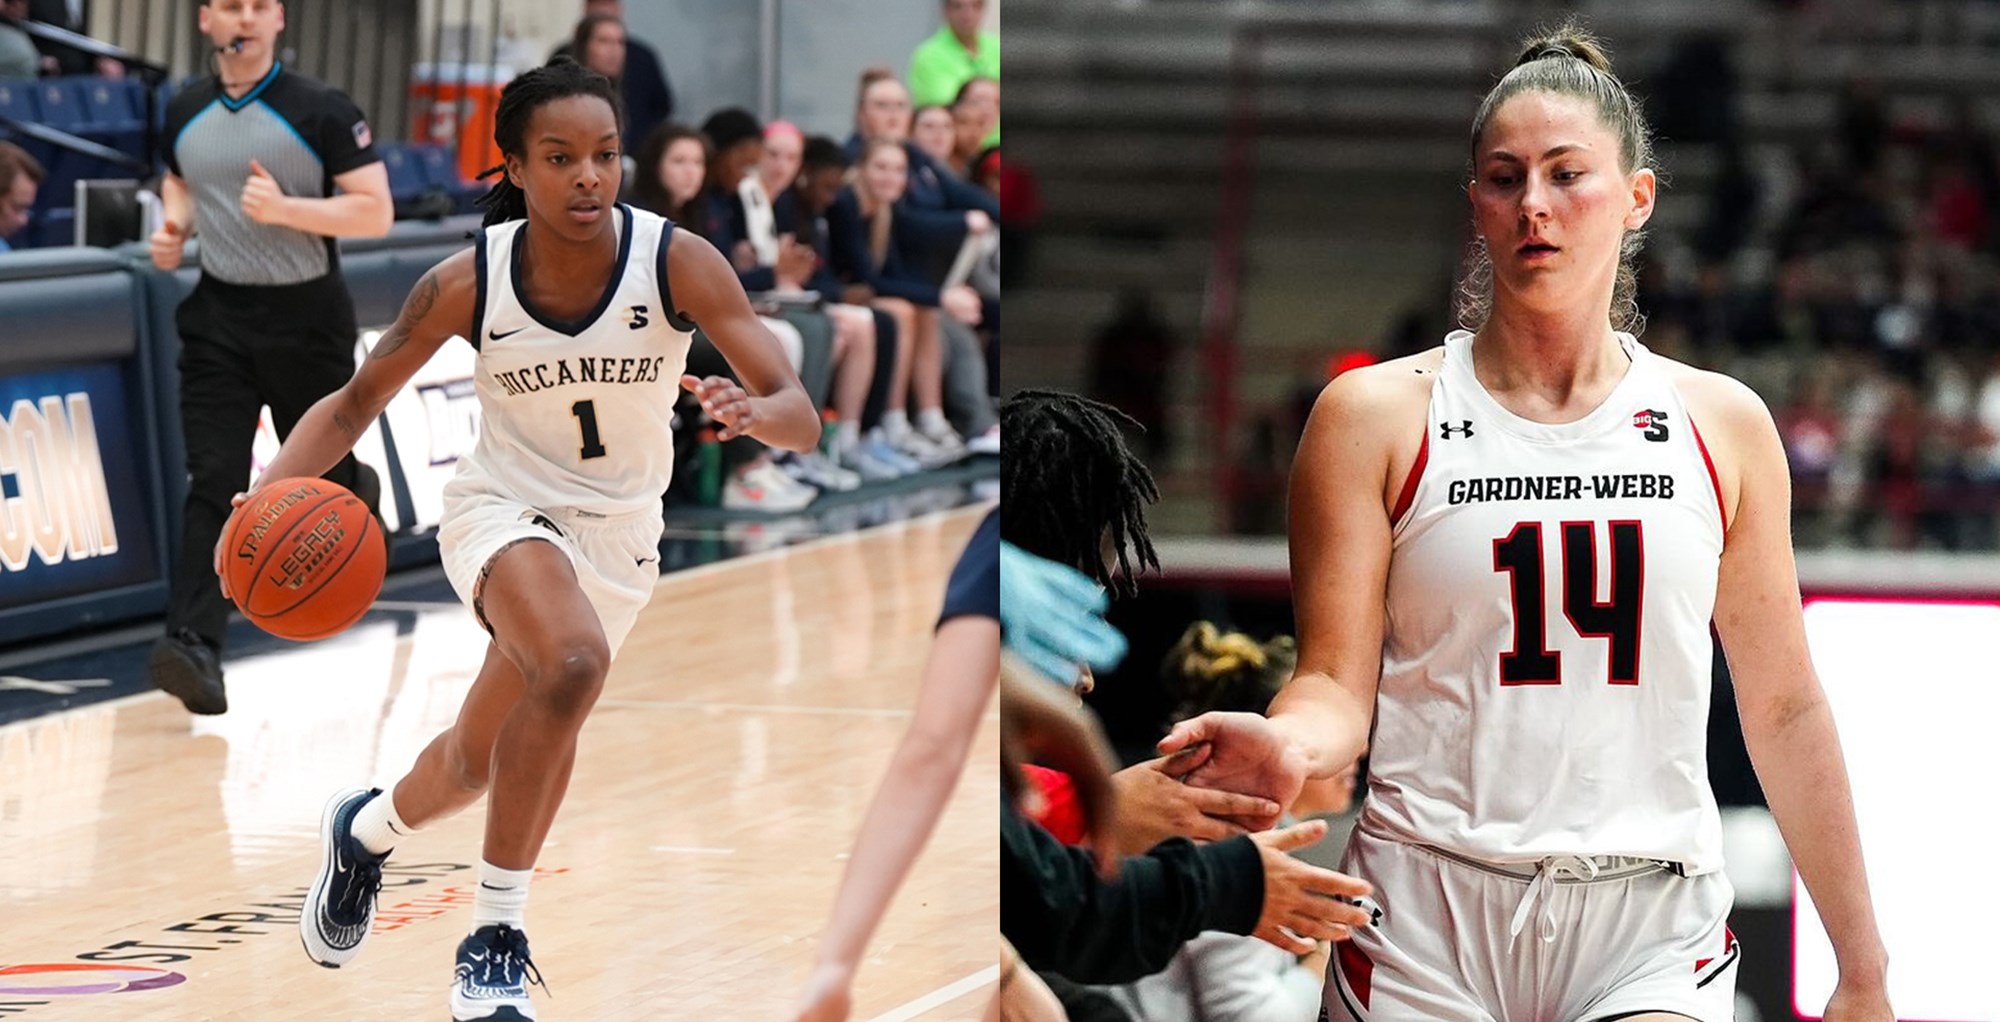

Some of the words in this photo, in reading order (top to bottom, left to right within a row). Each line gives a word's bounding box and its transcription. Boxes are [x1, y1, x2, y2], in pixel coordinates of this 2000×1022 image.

[494, 356, 664, 396] BUCCANEERS
[570, 399, 607, 462] 1
[1448, 474, 1675, 505] GARDNER-WEBB
[238, 486, 321, 566] SPALDING
[270, 510, 340, 587] LEGACY
[1492, 519, 1645, 686] 14
